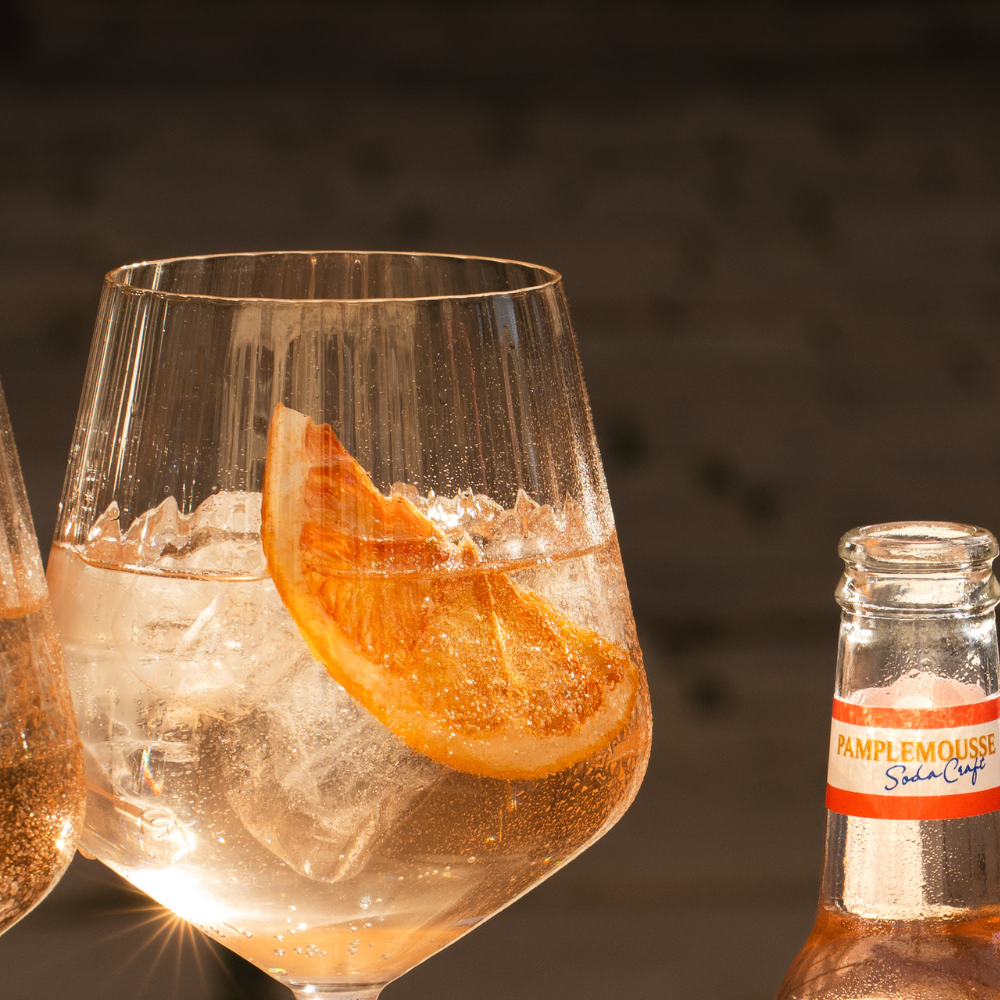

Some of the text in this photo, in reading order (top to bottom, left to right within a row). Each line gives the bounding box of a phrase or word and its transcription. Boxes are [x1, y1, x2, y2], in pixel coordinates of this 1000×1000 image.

[837, 733, 996, 762] PAMPLEMOUSSE
[884, 757, 986, 791] Soda Craft
